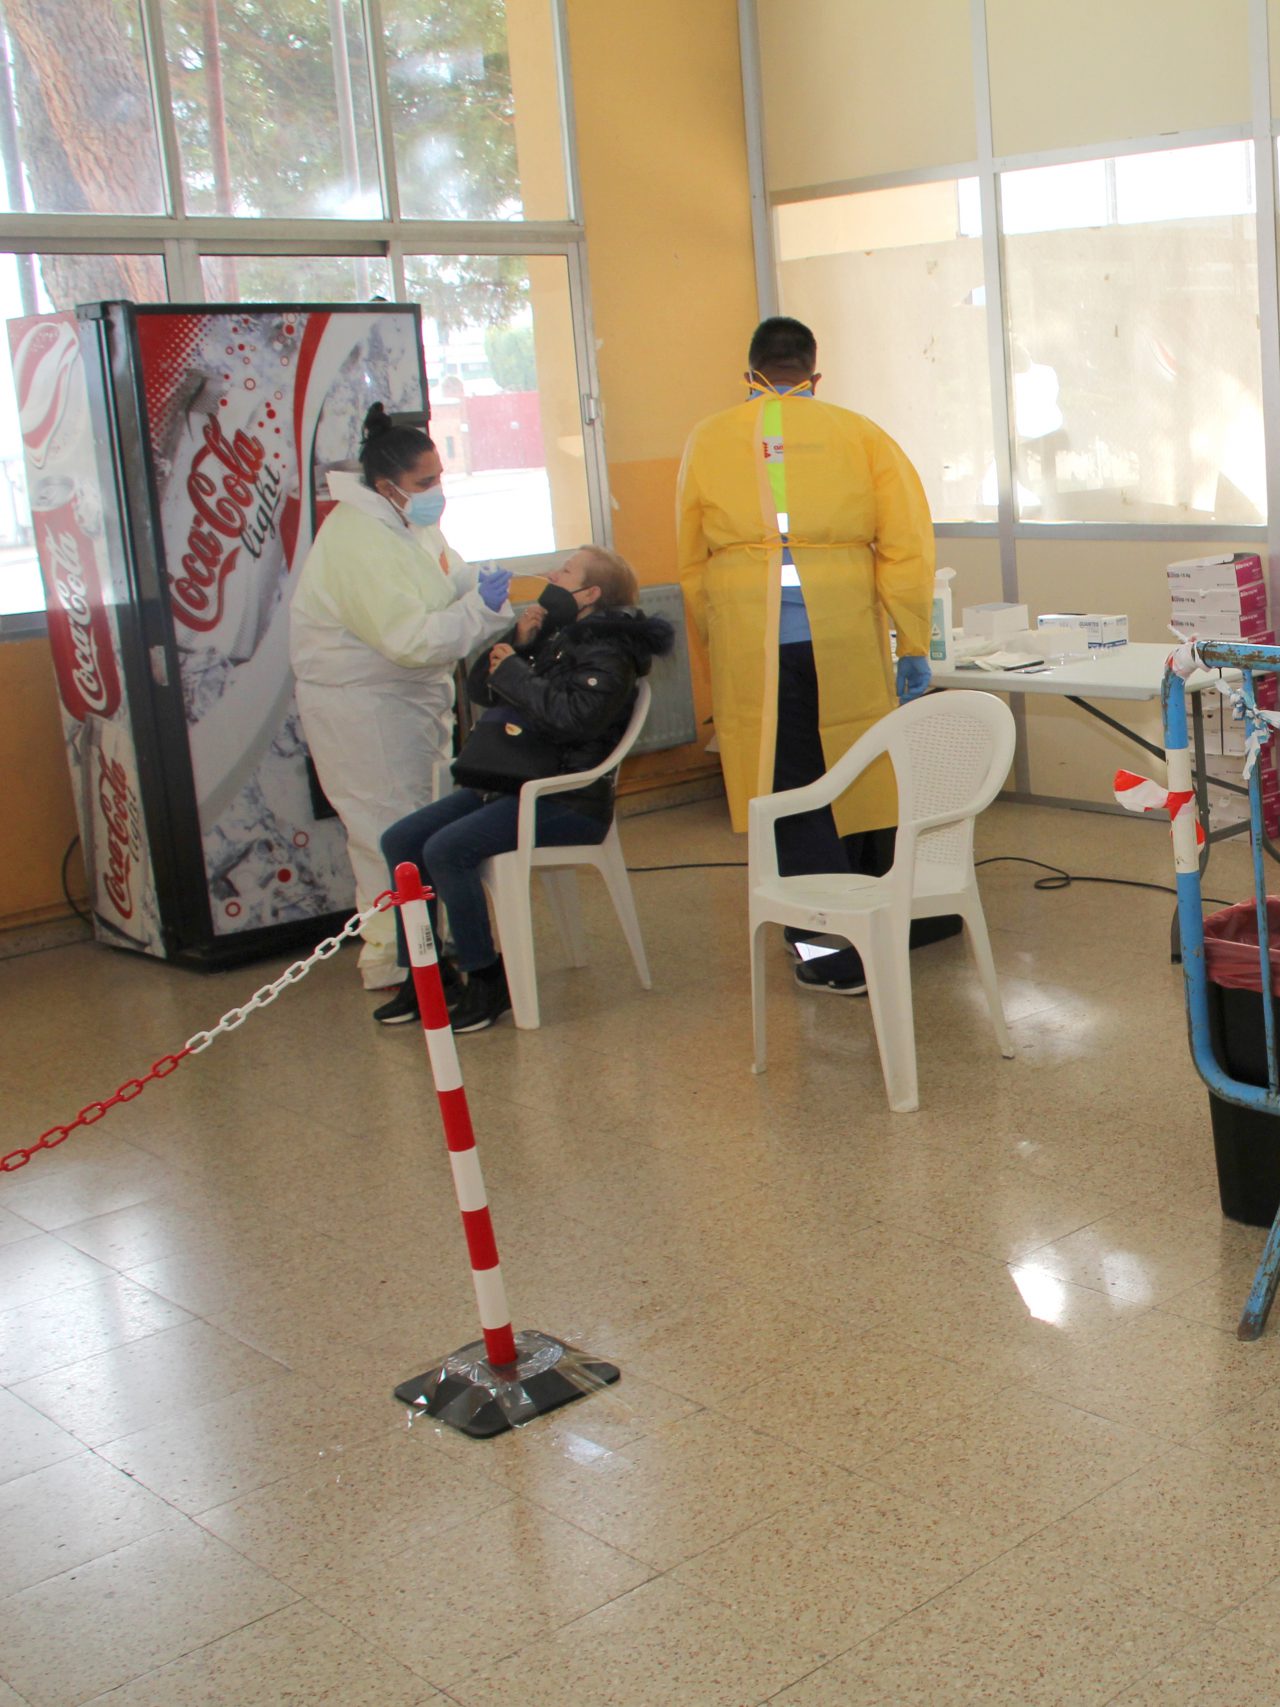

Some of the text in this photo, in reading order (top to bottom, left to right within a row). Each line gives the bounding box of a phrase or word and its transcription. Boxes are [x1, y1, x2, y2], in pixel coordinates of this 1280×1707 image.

[167, 412, 266, 632] Coca-Cola
[240, 464, 283, 559] light
[45, 523, 108, 712] Coca-Cola
[98, 745, 133, 919] Coca-Cola
